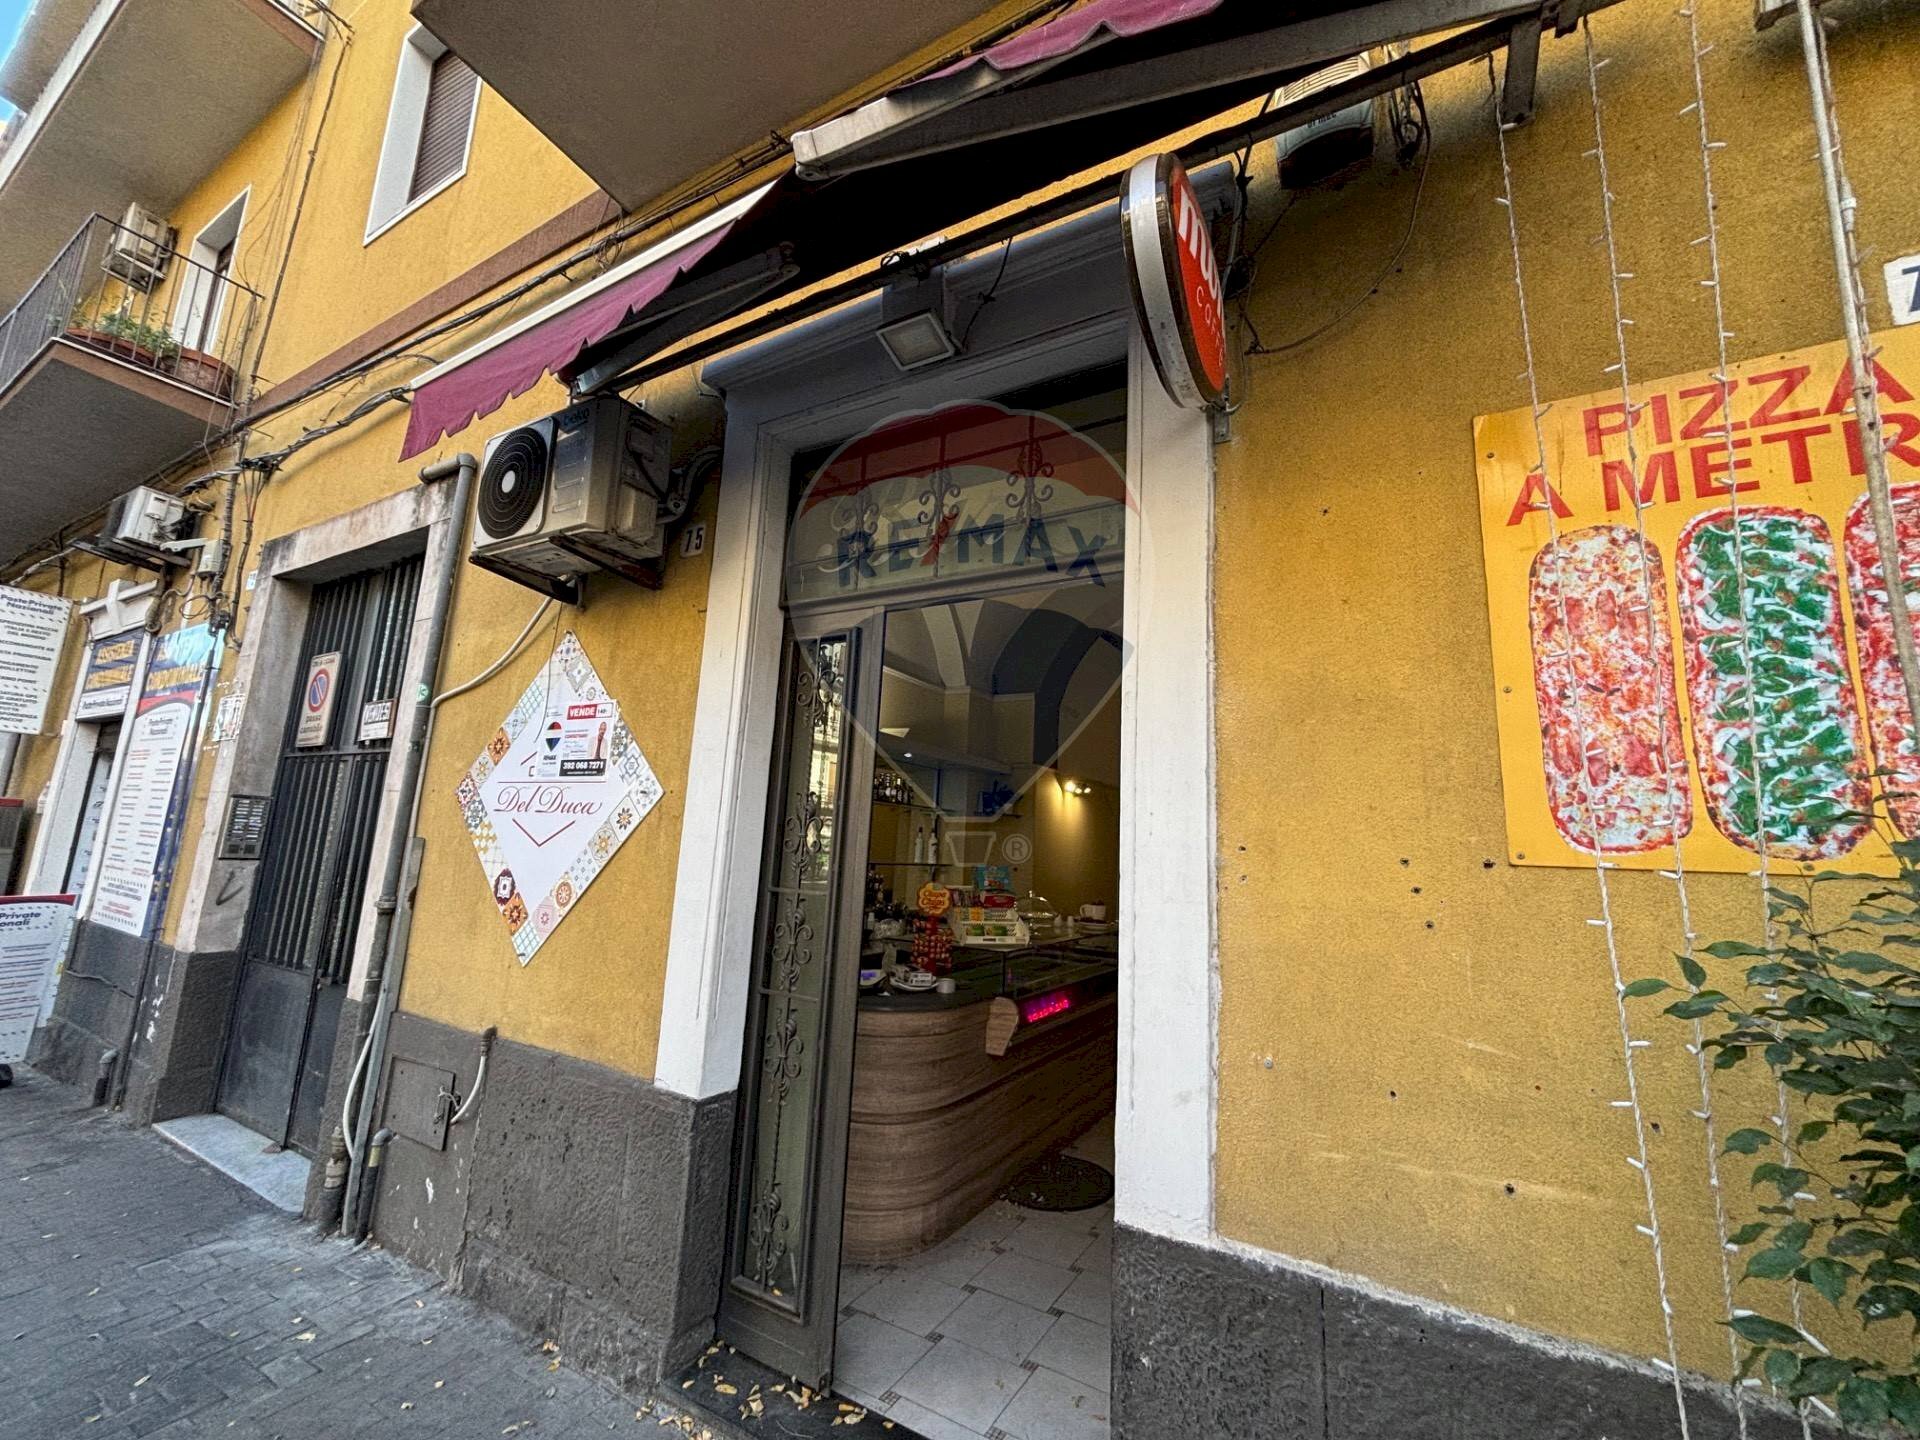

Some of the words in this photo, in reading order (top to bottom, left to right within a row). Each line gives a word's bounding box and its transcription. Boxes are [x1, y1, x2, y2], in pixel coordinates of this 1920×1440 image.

[1583, 357, 1915, 457] PIZZA
[1507, 474, 1575, 526] A
[569, 707, 595, 717] VENDE
[493, 786, 542, 813] Del
[535, 786, 603, 815] Duca
[0, 911, 41, 920] Private
